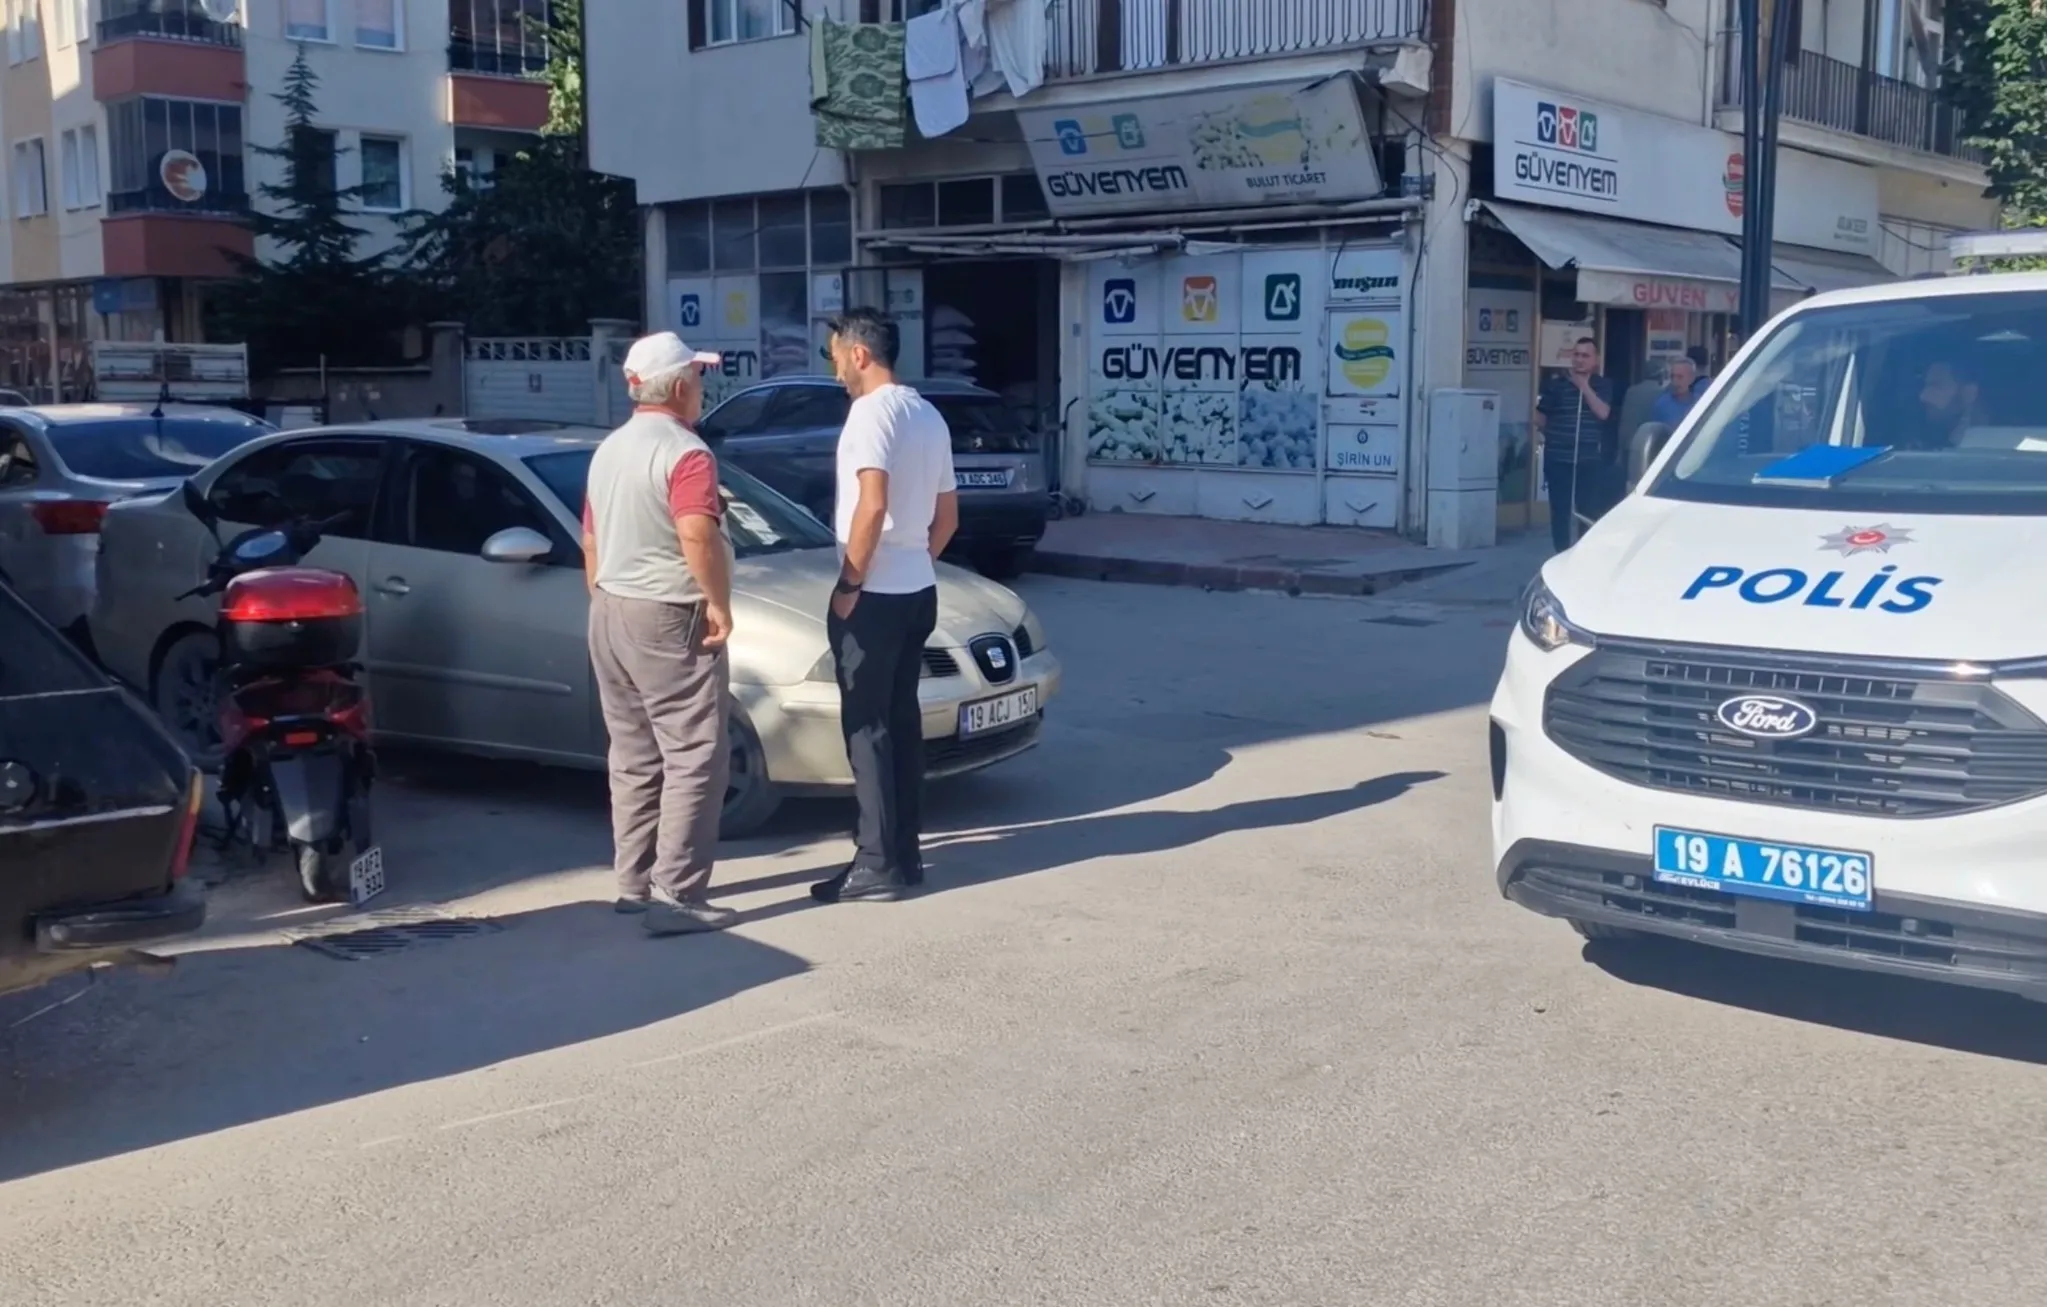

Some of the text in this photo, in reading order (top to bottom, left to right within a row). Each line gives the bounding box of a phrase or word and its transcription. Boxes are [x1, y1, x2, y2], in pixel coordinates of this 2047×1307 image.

[1047, 165, 1188, 197] GÜVENYEM
[1245, 175, 1279, 188] BULUT
[1515, 151, 1617, 196] GÜVENYEM
[1103, 343, 1302, 381] GÜVENYEM
[1337, 451, 1391, 466] ŞİRİN UN
[1680, 565, 1944, 614] POLİS
[970, 706, 984, 730] 19
[988, 698, 1010, 725] ACJ
[1733, 699, 1798, 732] Ford
[1674, 834, 1866, 895] 19 A 76126
